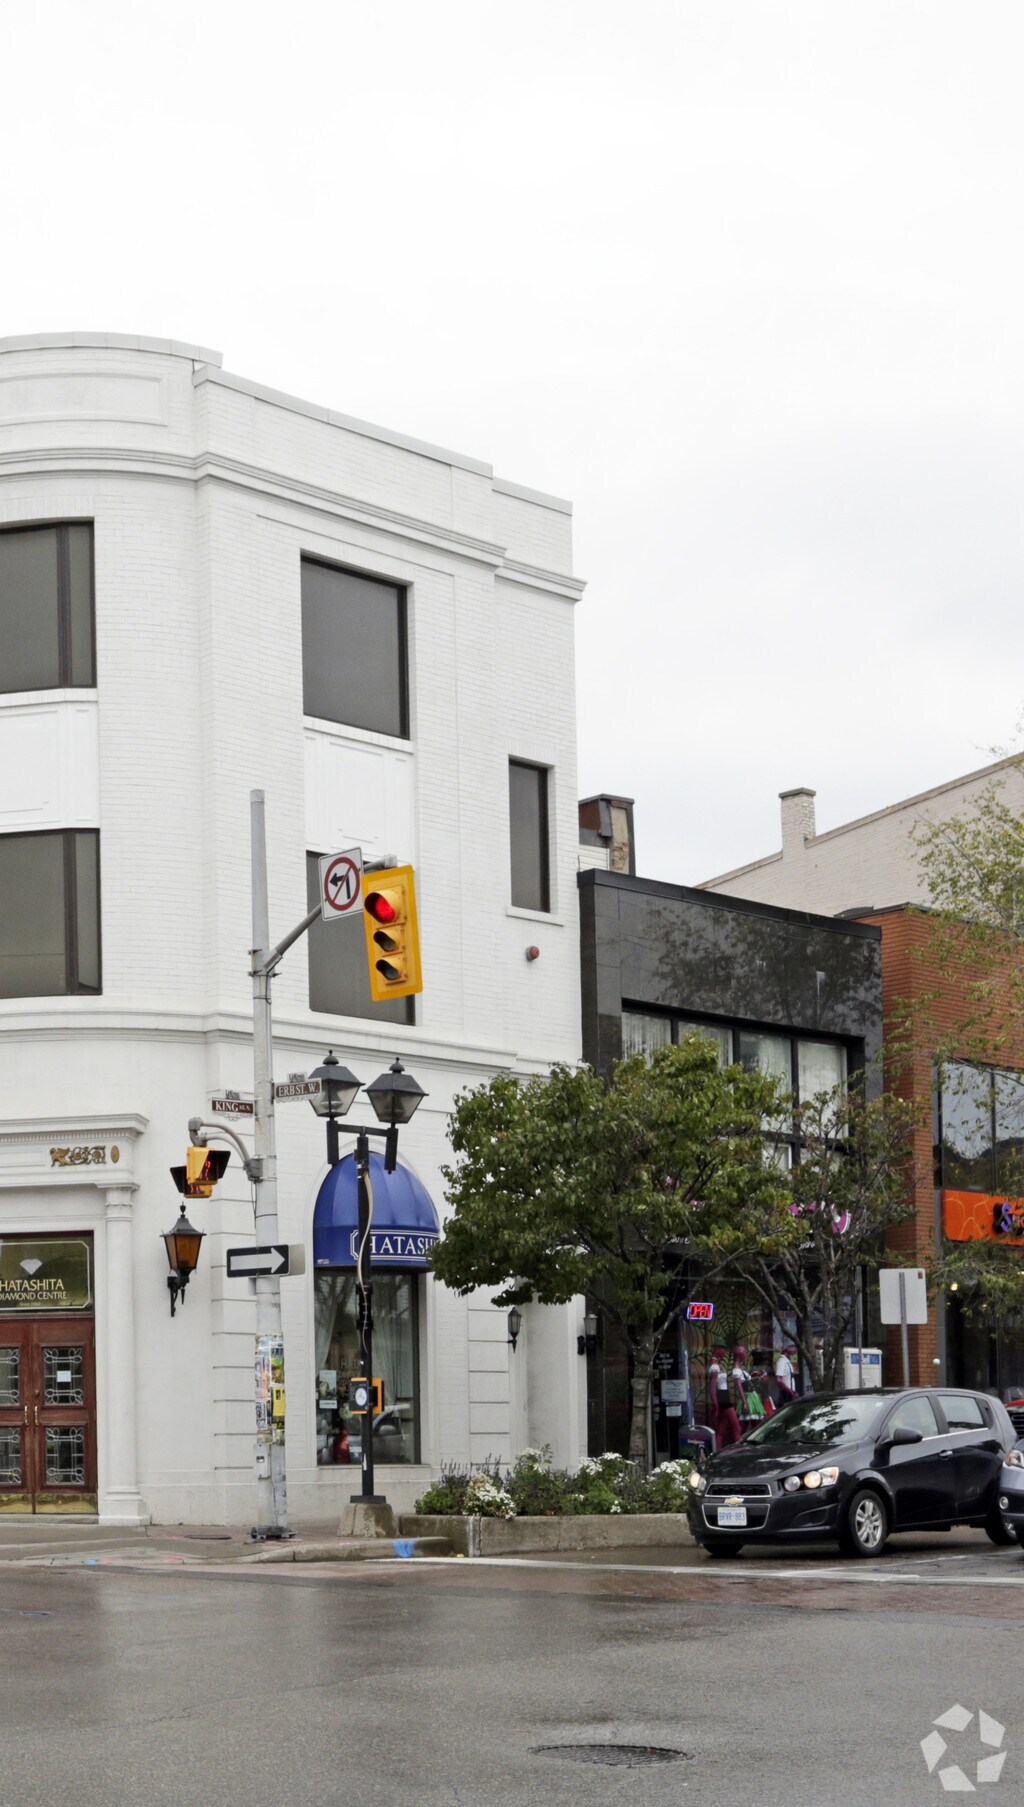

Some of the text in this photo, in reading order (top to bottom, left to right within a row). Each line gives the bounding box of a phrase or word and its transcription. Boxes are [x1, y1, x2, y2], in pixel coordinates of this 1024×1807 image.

[278, 1081, 319, 1097] ERB ST. W.
[216, 1100, 239, 1112] KING
[37, 1291, 67, 1300] CENTRE
[689, 1303, 712, 1318] OPEN
